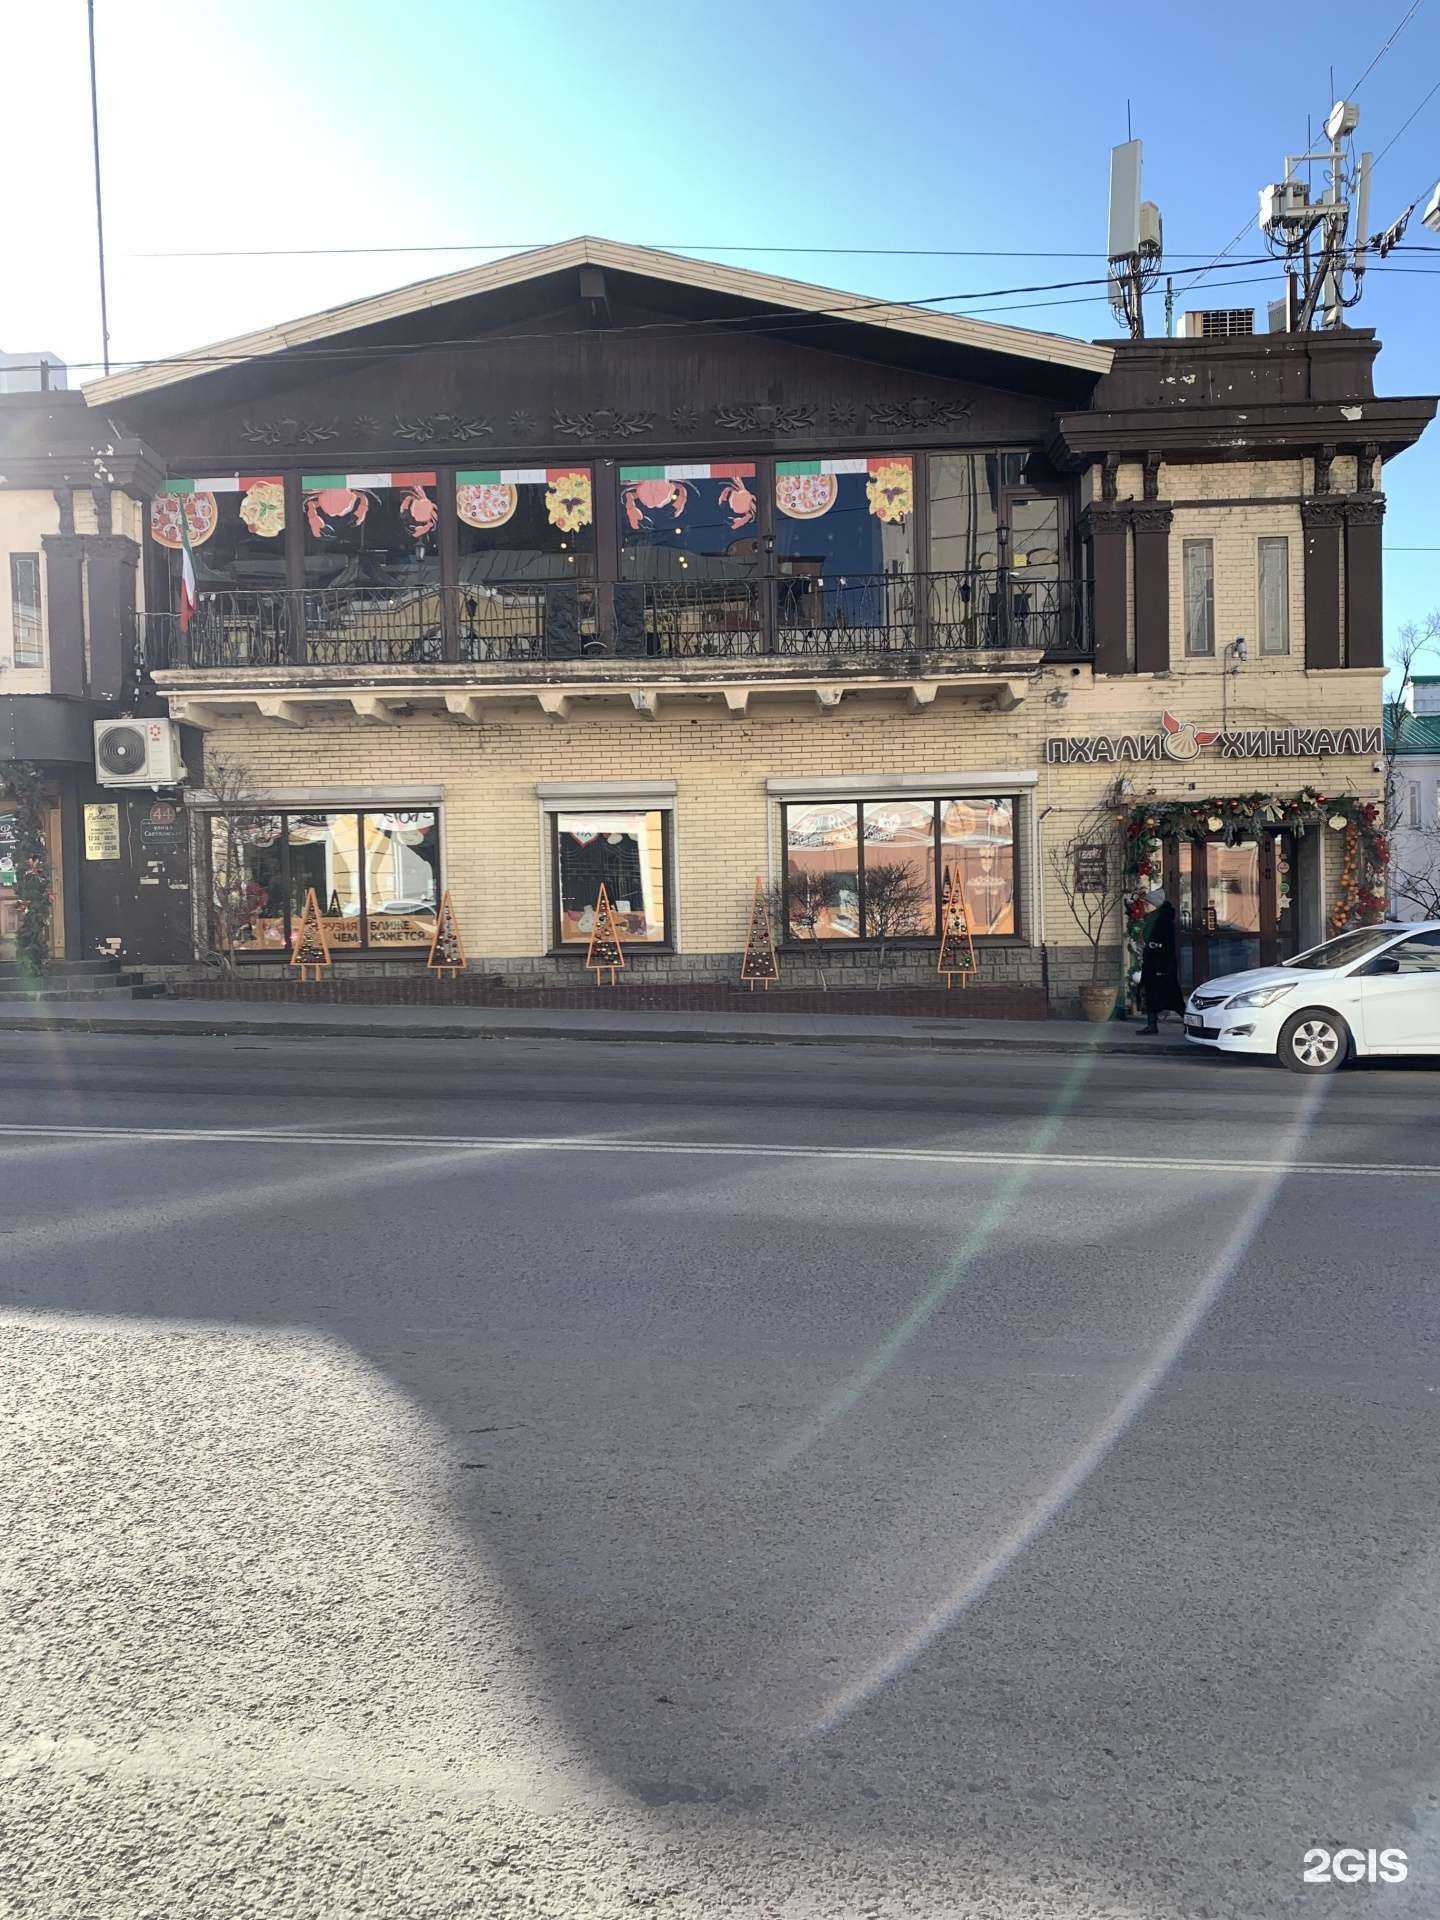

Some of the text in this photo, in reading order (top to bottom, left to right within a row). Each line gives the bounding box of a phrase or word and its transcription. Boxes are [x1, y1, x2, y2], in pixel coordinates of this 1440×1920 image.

[1047, 727, 1383, 763] ПХАЛИ ХИНКАЛИ
[152, 807, 173, 820] 44
[333, 933, 358, 942] ЧЕМ
